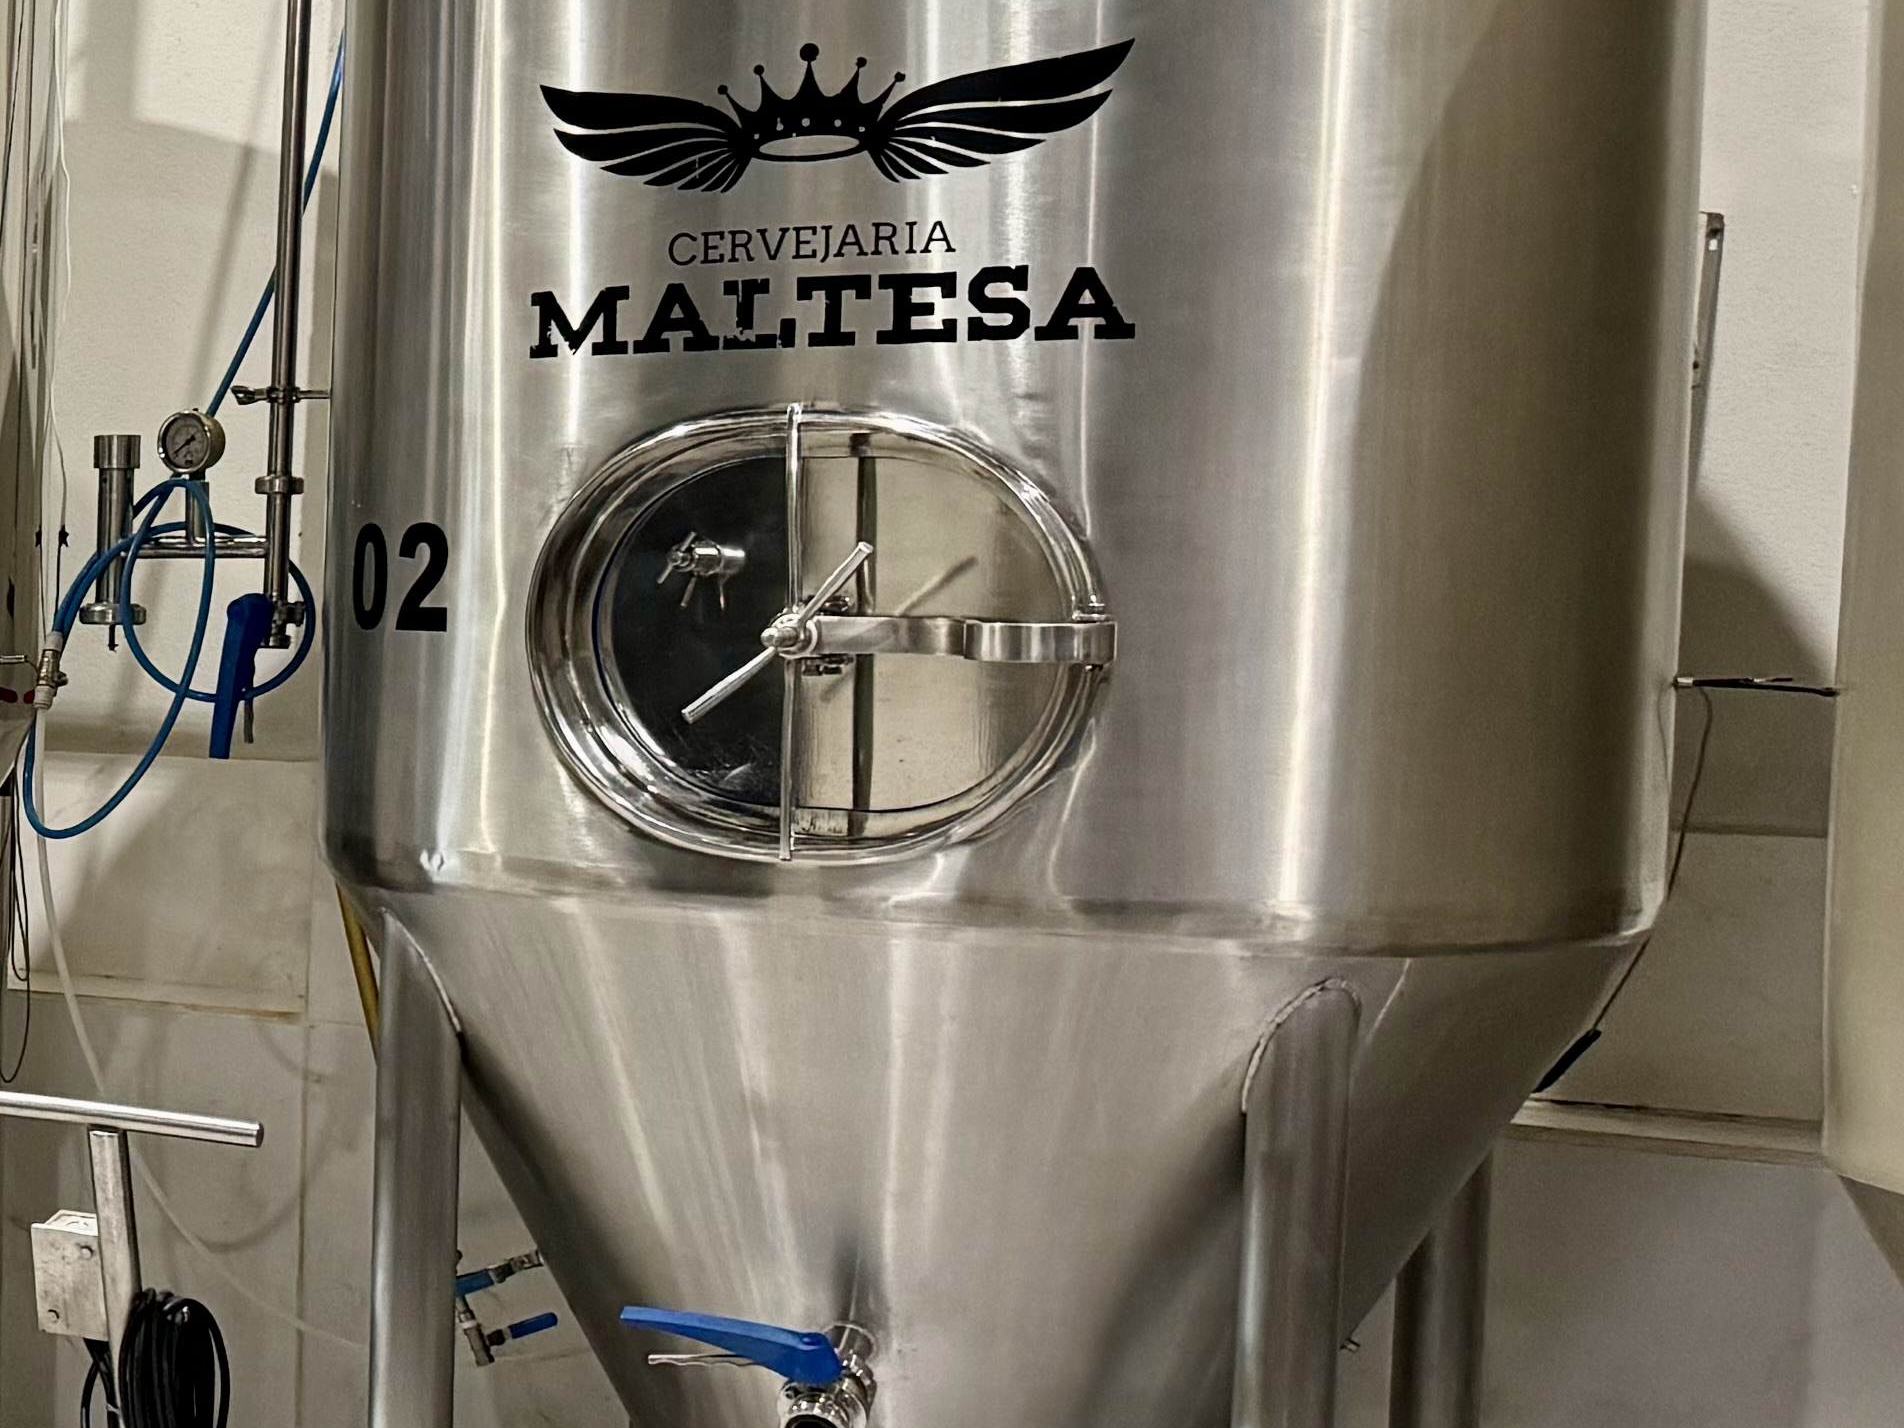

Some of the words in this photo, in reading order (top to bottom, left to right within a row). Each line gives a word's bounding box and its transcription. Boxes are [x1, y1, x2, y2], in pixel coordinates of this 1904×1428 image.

[667, 220, 957, 267] CERVEJARIA
[528, 264, 1137, 359] MALTESA
[352, 522, 450, 632] 02
